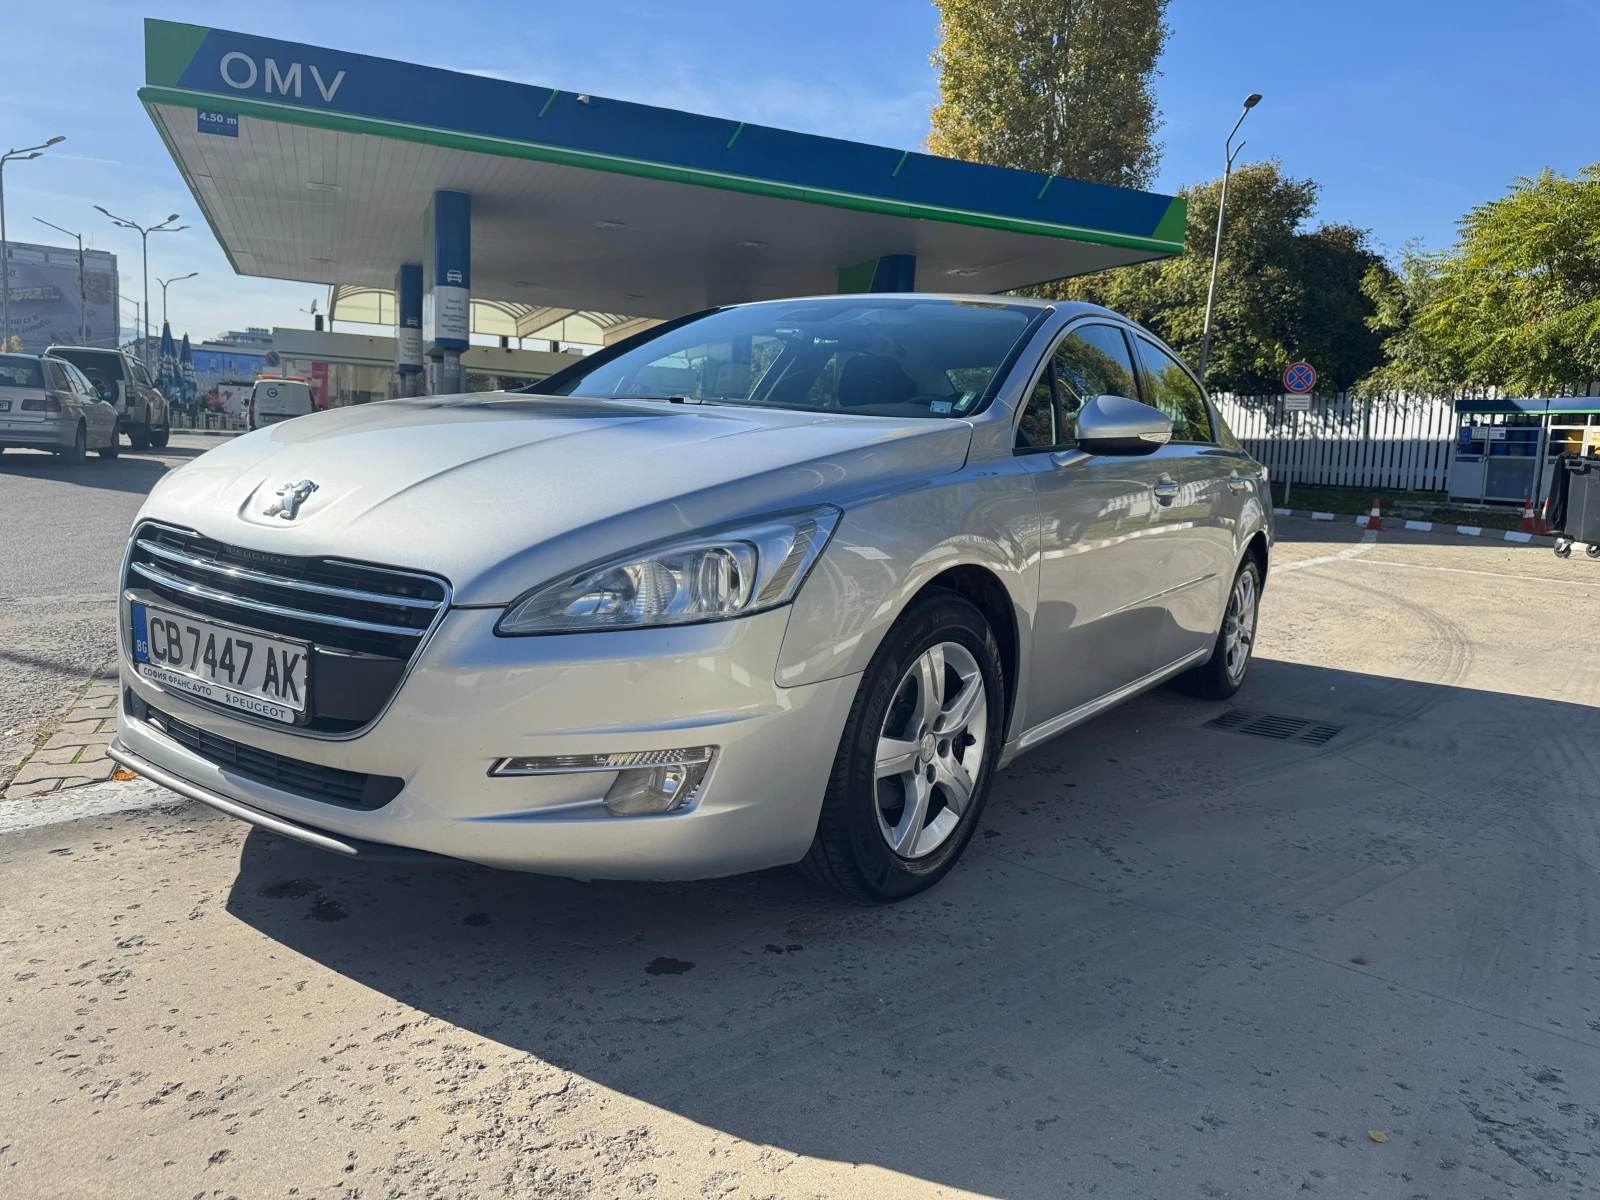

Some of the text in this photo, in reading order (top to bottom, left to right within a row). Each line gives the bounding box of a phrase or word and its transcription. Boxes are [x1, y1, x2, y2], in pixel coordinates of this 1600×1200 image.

[220, 51, 346, 102] OMV
[199, 112, 224, 123] 4.50
[230, 547, 290, 565] PEUGEOT
[136, 639, 148, 654] BG
[143, 667, 212, 696] СОФИЯ ФРАНС АУТО
[232, 695, 286, 719] PEUGEOT
